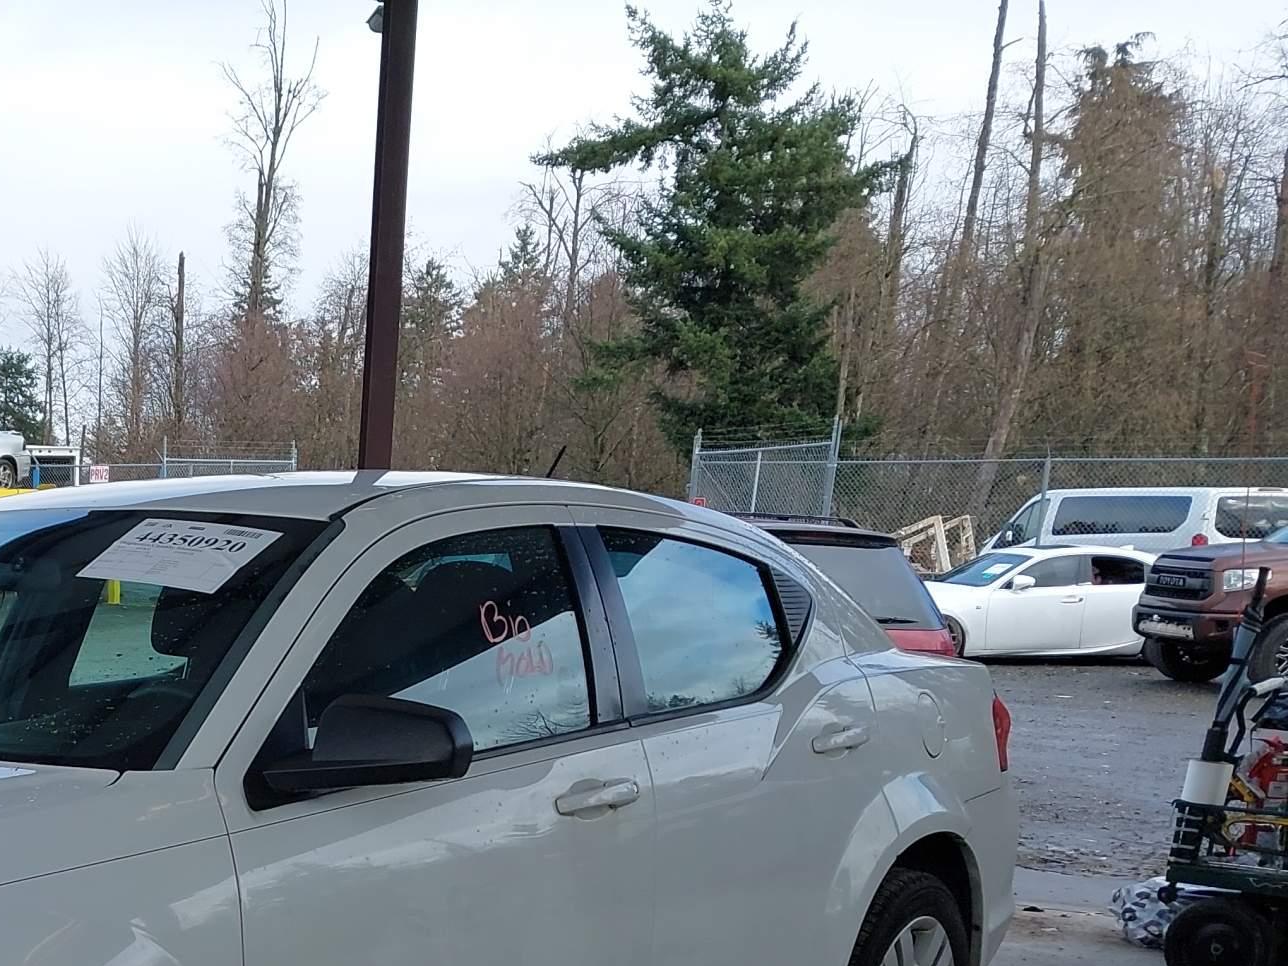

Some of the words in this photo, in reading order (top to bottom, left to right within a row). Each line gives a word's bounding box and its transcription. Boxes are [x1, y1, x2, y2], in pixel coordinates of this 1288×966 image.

[91, 468, 108, 481] PRV2
[135, 531, 247, 553] 44350920
[1158, 575, 1184, 586] TOYOTA
